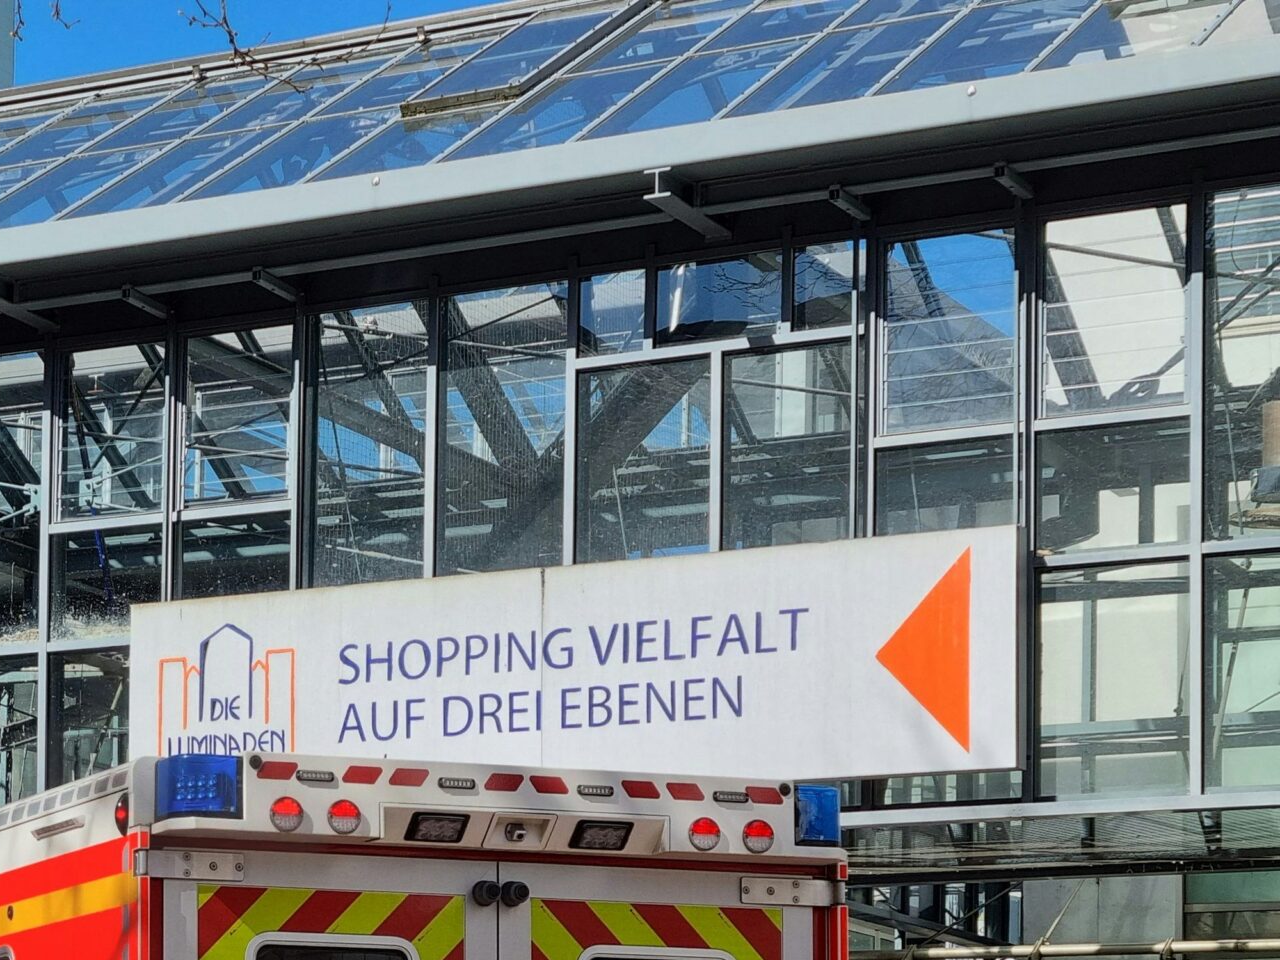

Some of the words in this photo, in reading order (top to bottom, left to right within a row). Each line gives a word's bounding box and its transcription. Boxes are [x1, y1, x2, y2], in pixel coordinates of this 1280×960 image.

[338, 627, 574, 686] SHOPPING
[587, 607, 809, 667] VIELFALT
[210, 695, 240, 722] DIE
[337, 697, 426, 743] AUF
[441, 690, 542, 738] DREI
[560, 675, 743, 730] EBENEN
